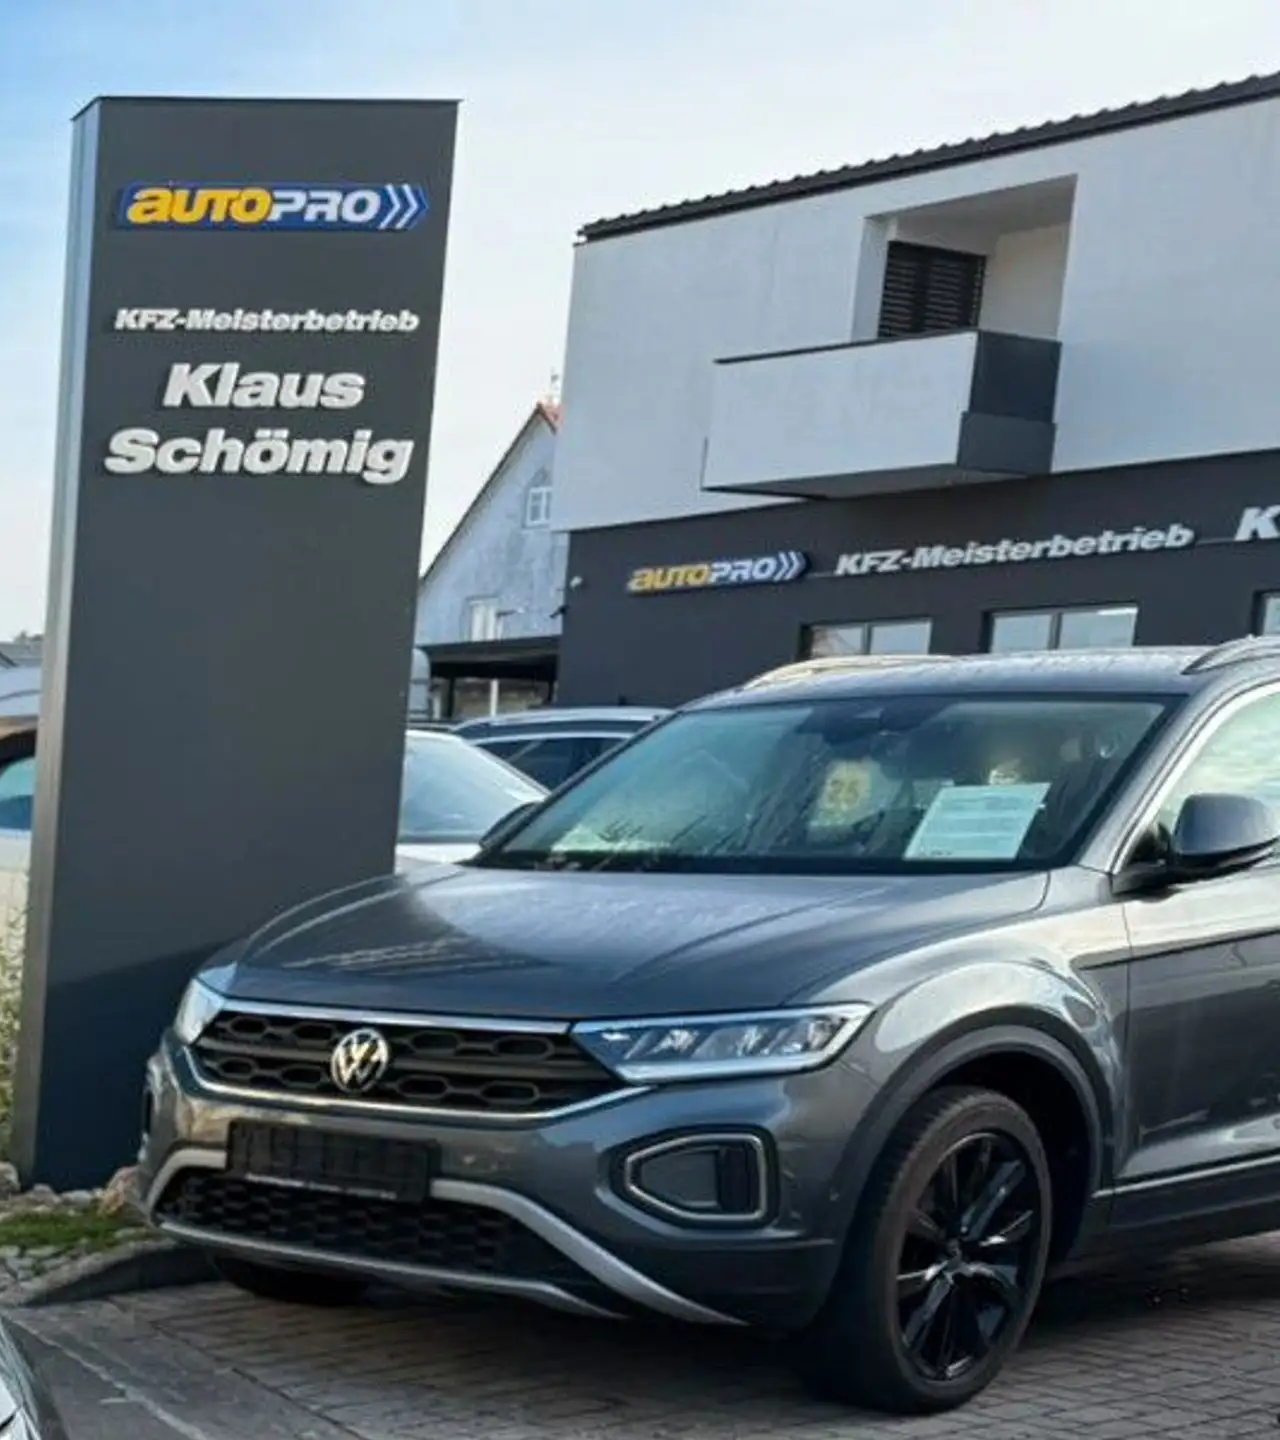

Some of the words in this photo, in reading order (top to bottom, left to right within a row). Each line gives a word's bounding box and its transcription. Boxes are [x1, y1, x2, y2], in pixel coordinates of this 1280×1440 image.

[114, 308, 420, 331] KFZ-Meisterbetrieb
[163, 363, 365, 408] Klaus
[105, 429, 414, 483] Schömig
[834, 523, 1195, 576] KFZ-Meisterbetrieb
